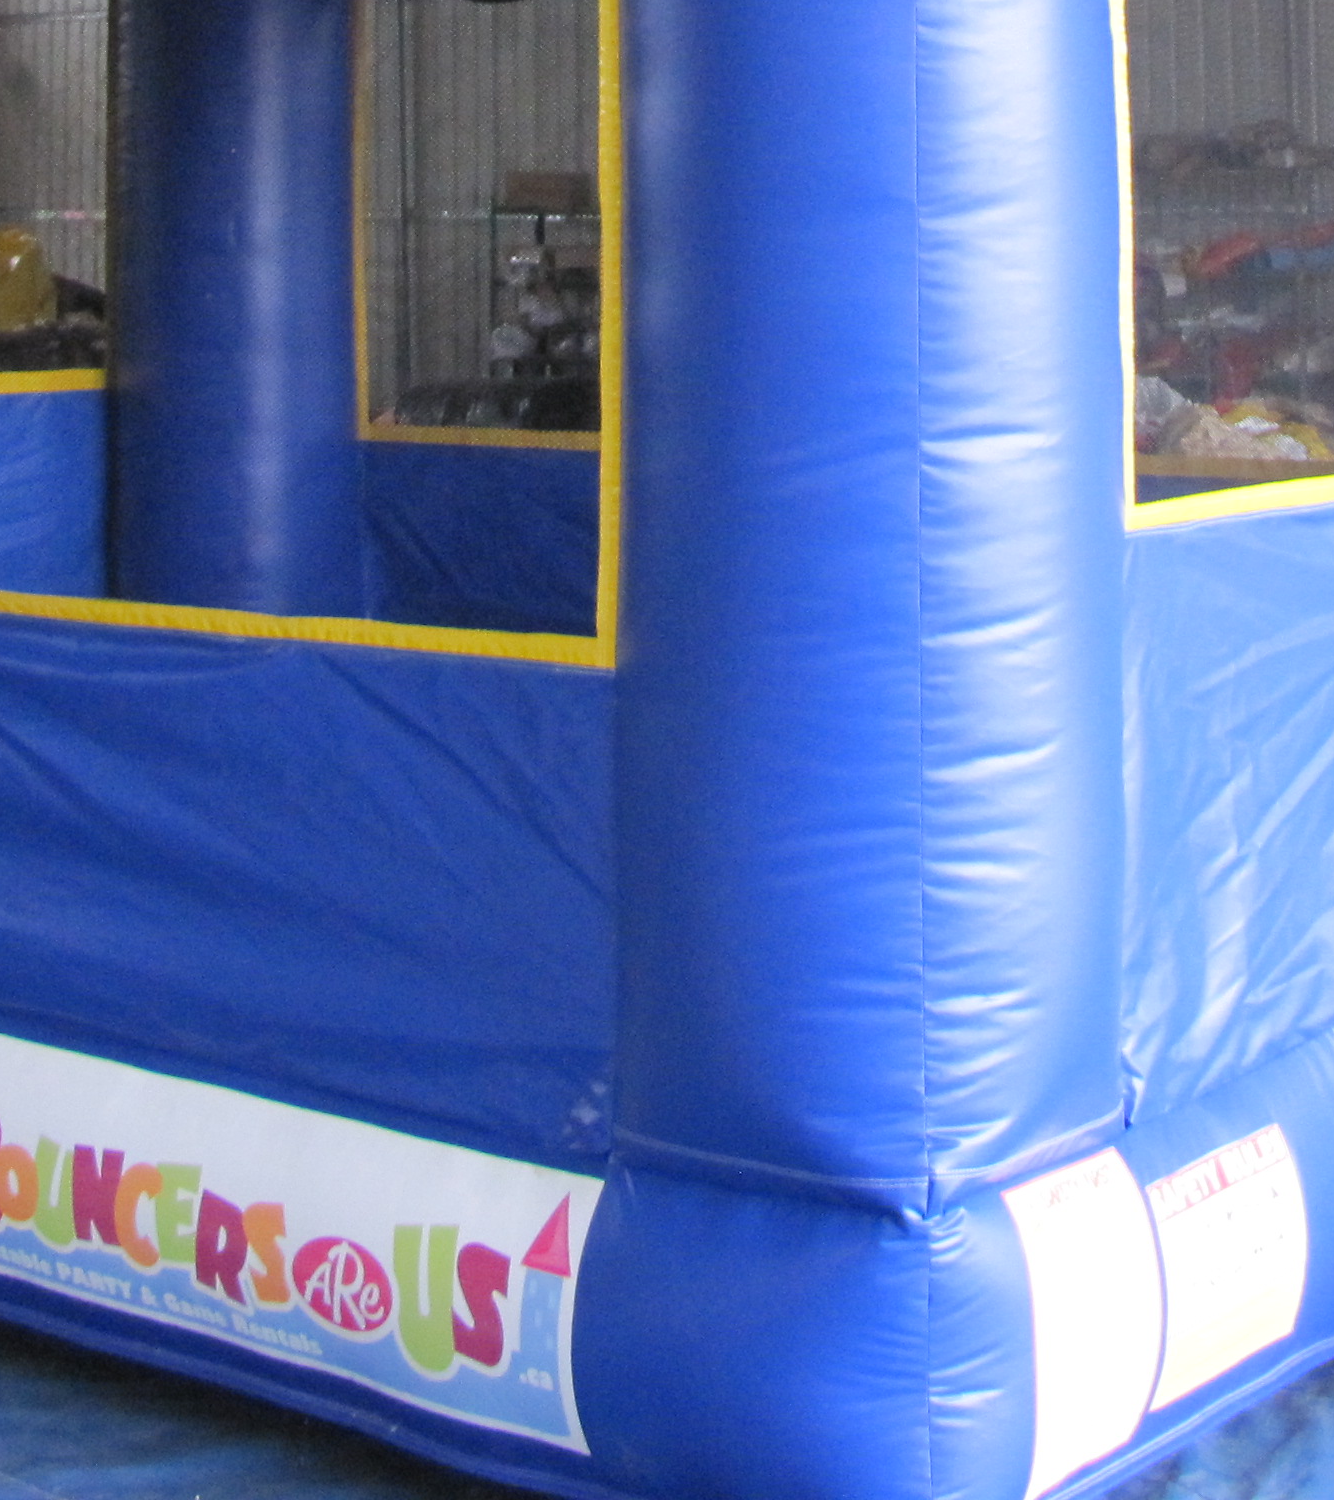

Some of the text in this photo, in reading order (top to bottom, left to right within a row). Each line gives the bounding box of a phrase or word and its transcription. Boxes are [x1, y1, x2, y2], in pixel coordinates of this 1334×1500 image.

[56, 1262, 131, 1300] PARTY
[231, 1313, 323, 1355] Rentals
[392, 1225, 511, 1372] US
